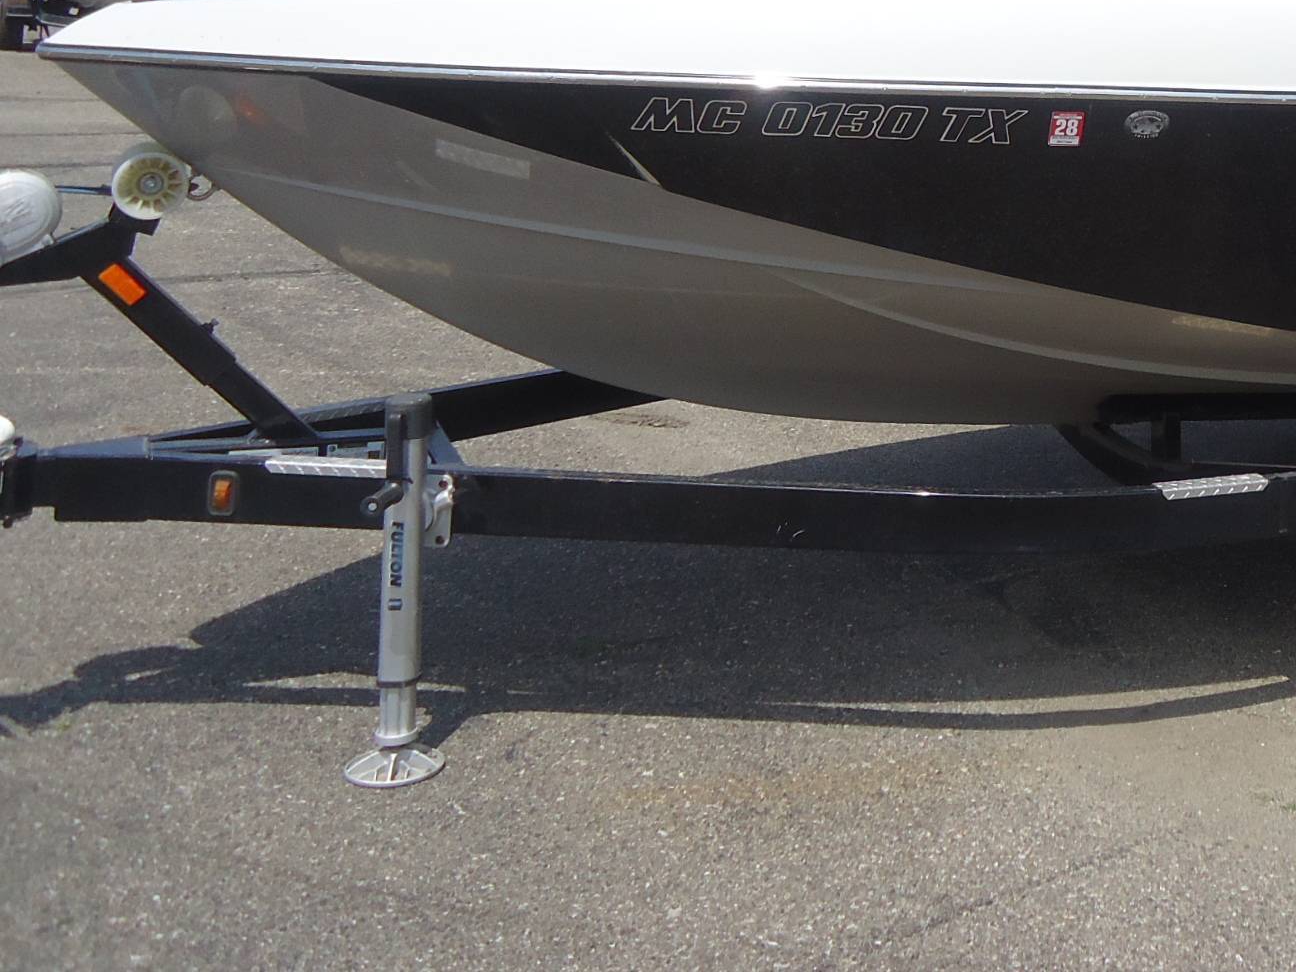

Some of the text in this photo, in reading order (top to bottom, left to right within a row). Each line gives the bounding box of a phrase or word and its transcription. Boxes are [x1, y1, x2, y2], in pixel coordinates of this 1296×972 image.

[630, 96, 1029, 145] MC 0130 TX
[1054, 119, 1079, 136] 28
[389, 521, 405, 588] FULTON
